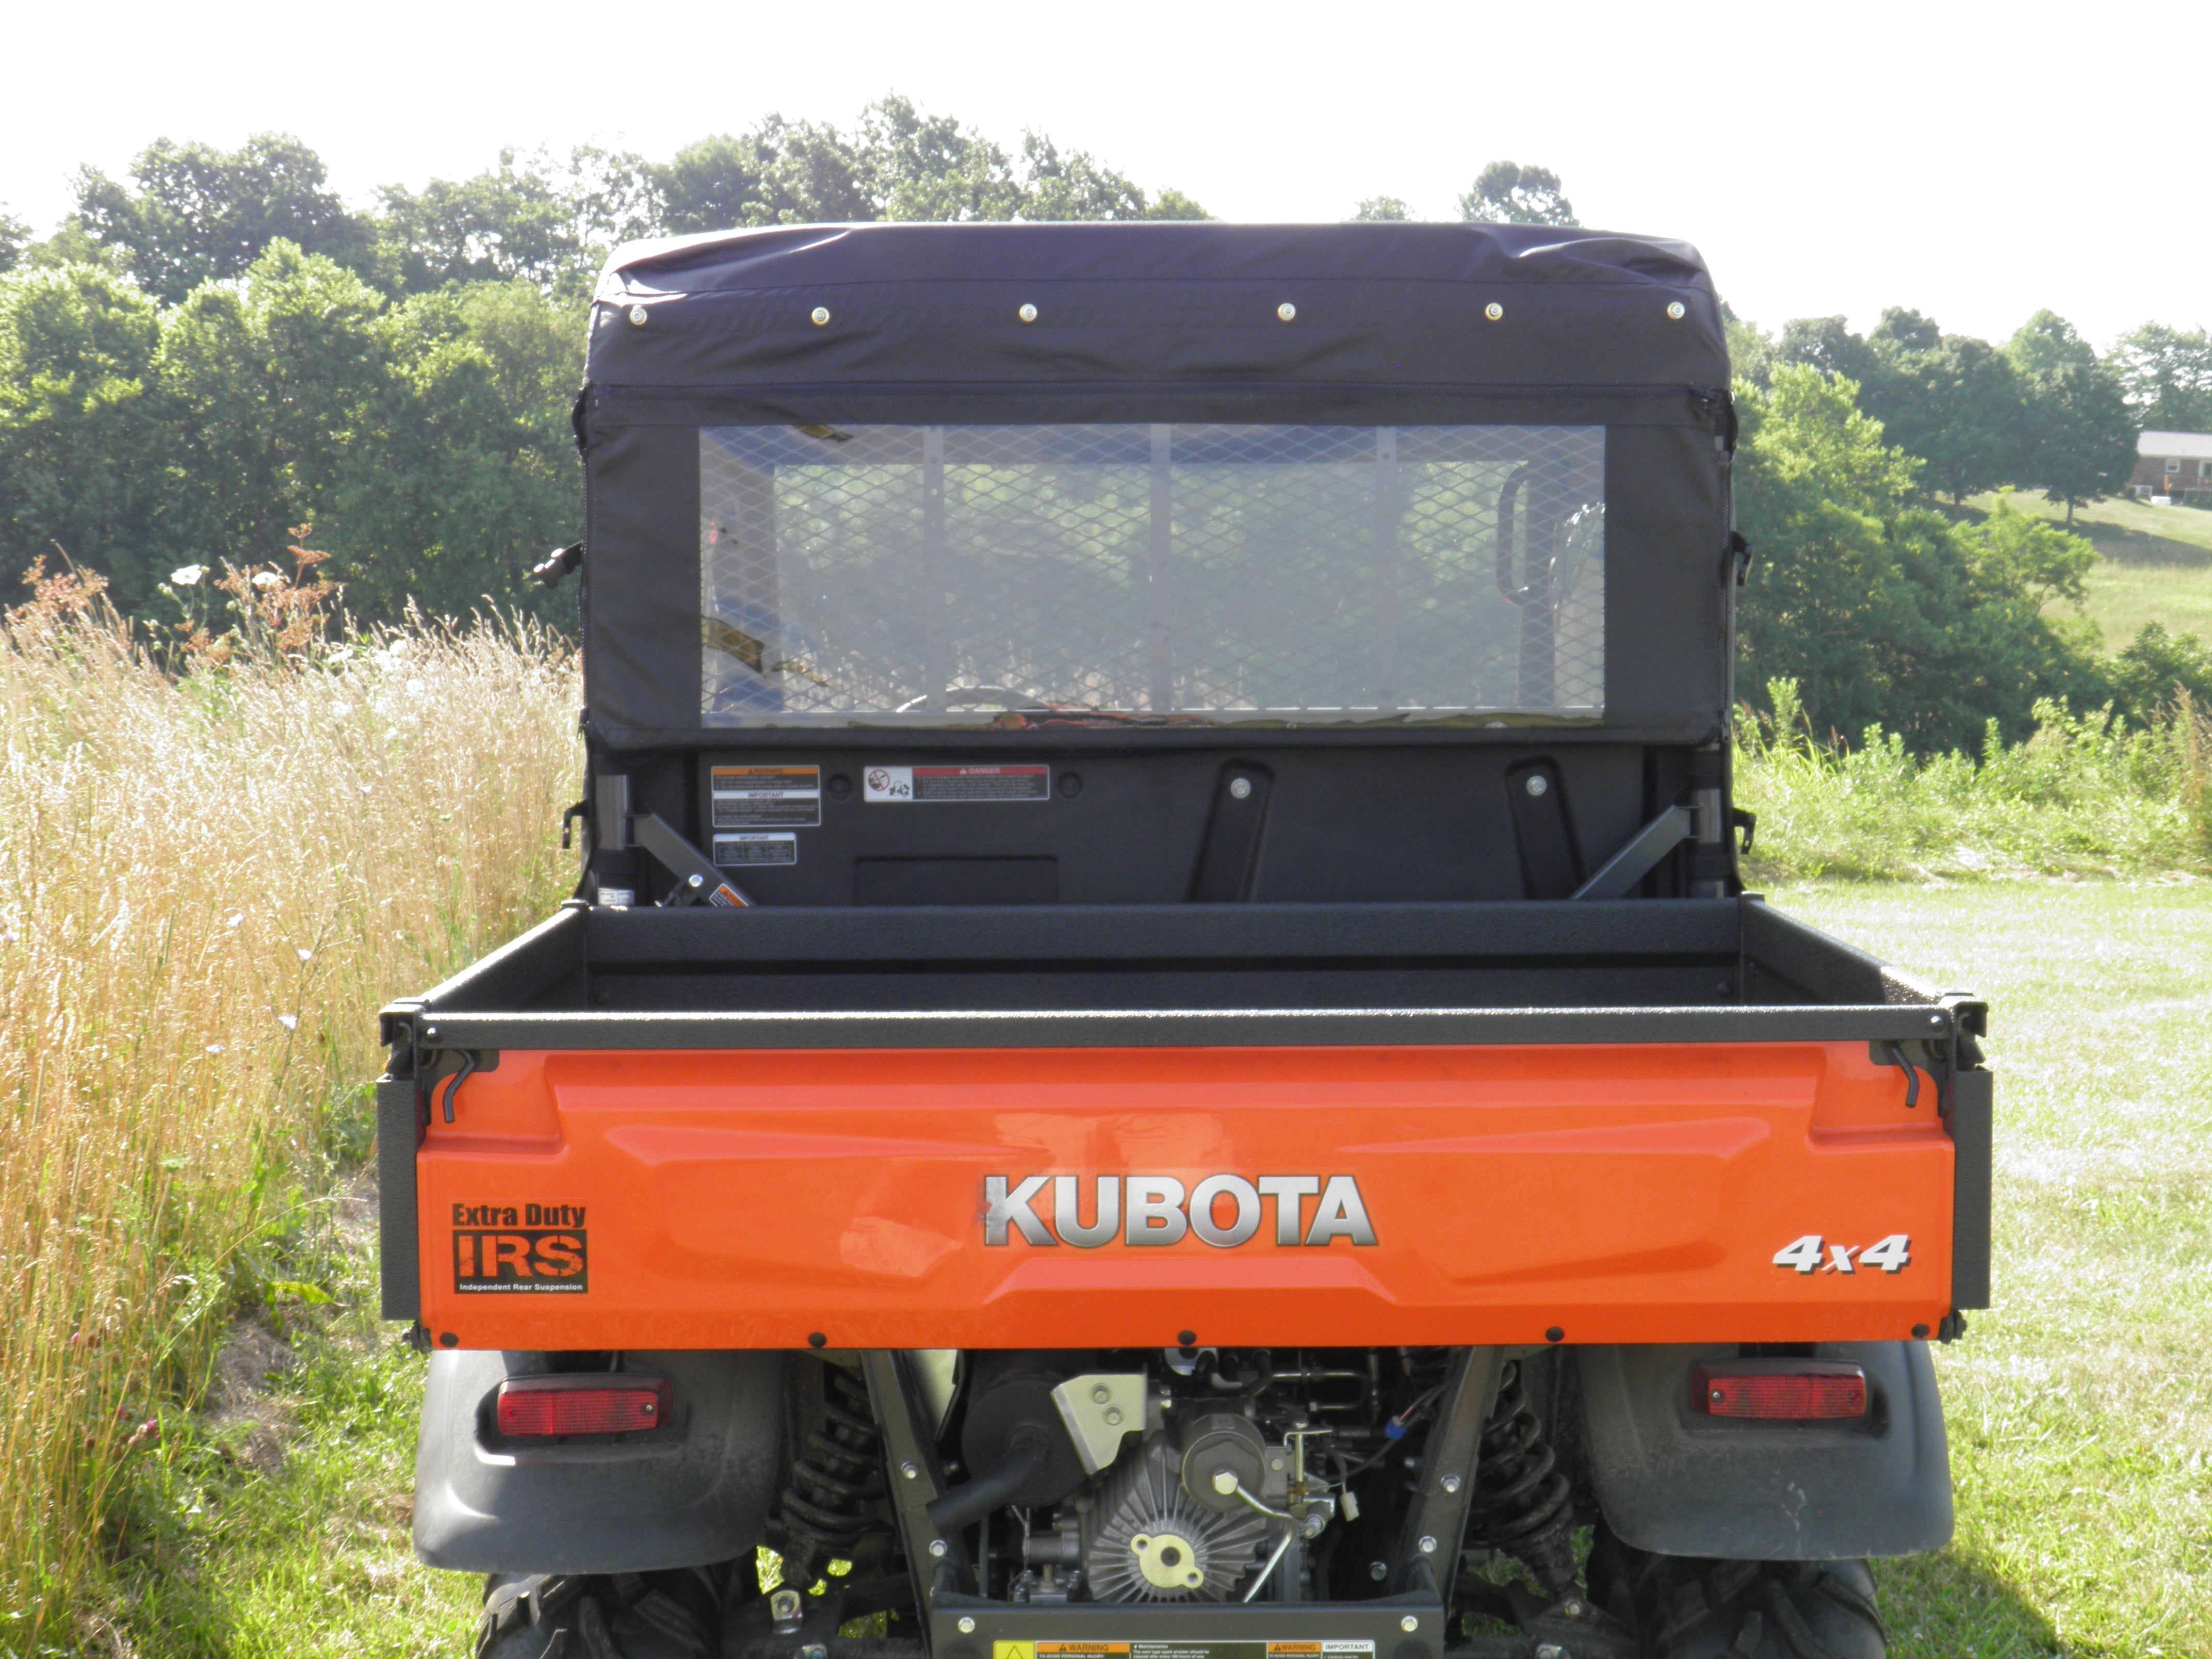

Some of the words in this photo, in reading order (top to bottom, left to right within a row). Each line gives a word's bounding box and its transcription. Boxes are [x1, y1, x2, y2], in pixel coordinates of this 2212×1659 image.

[452, 1203, 518, 1226] Extra
[525, 1203, 587, 1228] Duty
[984, 1174, 1378, 1247] KUBOTA
[458, 1235, 583, 1277] IRS
[1772, 1234, 1911, 1274] 4x4
[459, 1283, 511, 1292] Independent
[534, 1283, 582, 1292] Suspension
[1069, 1644, 1109, 1652] WARNING
